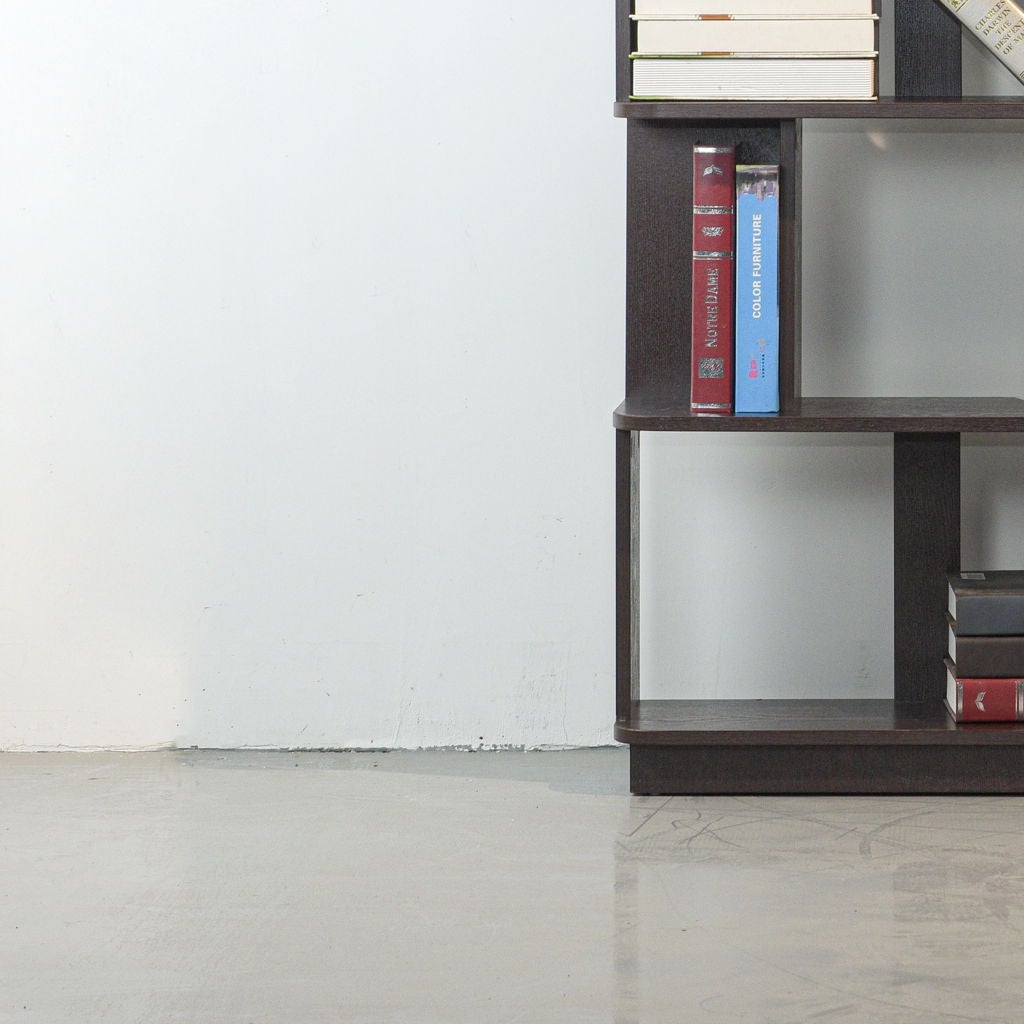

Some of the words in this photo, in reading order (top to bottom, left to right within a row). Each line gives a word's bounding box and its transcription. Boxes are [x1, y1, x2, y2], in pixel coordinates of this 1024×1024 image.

[982, 7, 1012, 36] DARWIN
[995, 20, 1012, 36] THE
[1002, 43, 1014, 55] OF
[753, 214, 761, 277] FURNITURE
[705, 268, 719, 304] DAME
[752, 280, 761, 319] COLOR
[704, 306, 718, 348] NOTRE
